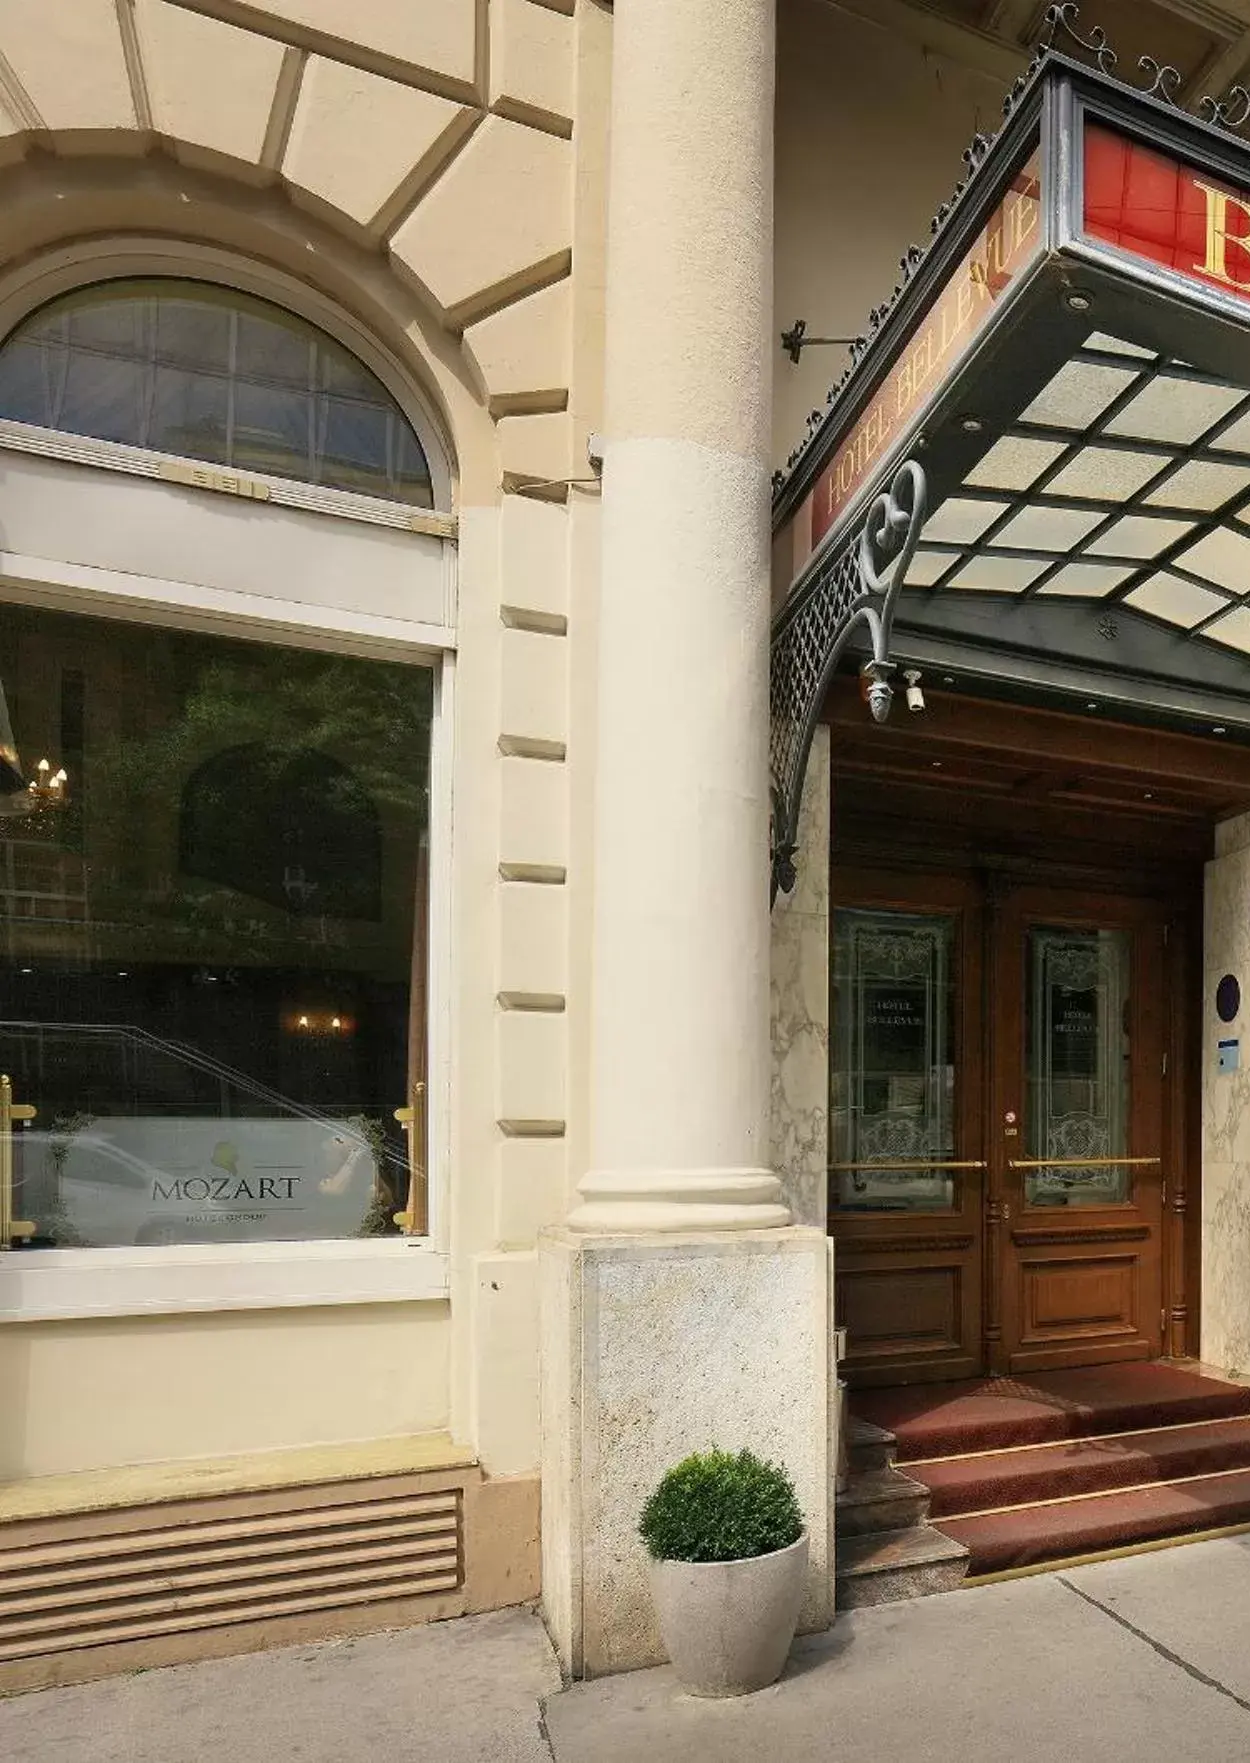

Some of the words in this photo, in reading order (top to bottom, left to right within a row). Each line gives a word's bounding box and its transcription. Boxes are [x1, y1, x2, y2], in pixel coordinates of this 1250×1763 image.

[827, 404, 894, 515] HOTEL
[896, 176, 1038, 418] BELLEVUE
[151, 1176, 302, 1201] MOZART
